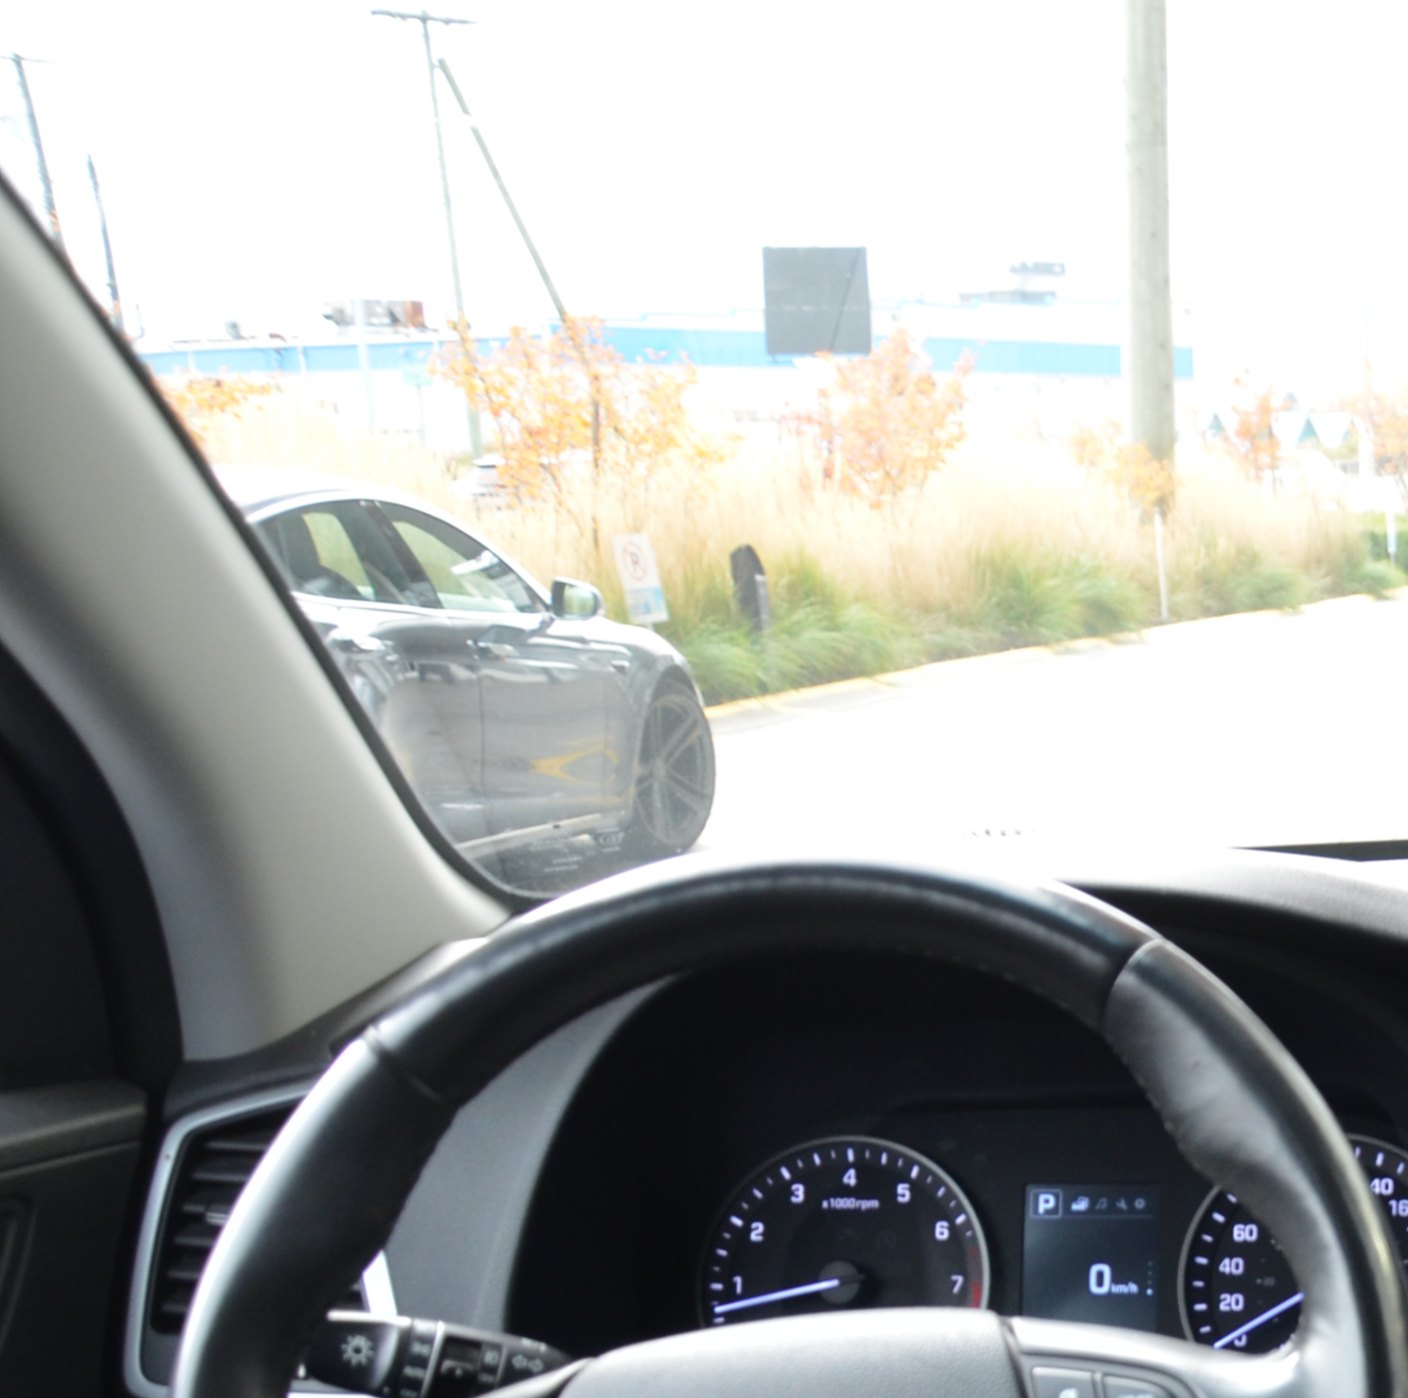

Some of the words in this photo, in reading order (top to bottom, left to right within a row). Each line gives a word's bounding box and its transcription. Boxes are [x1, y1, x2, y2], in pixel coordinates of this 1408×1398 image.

[843, 1168, 857, 1186] 4
[1370, 1178, 1394, 1195] 40
[791, 1183, 805, 1203] 3
[897, 1183, 911, 1202] 5
[1038, 1193, 1056, 1215] P
[750, 1222, 764, 1242] 2
[935, 1221, 949, 1241] 6
[1232, 1224, 1258, 1242] 60
[1219, 1257, 1244, 1275] 40
[732, 1276, 742, 1295] 1
[950, 1275, 963, 1294] 7
[1089, 1263, 1111, 1295] 0
[1219, 1293, 1244, 1311] 20
